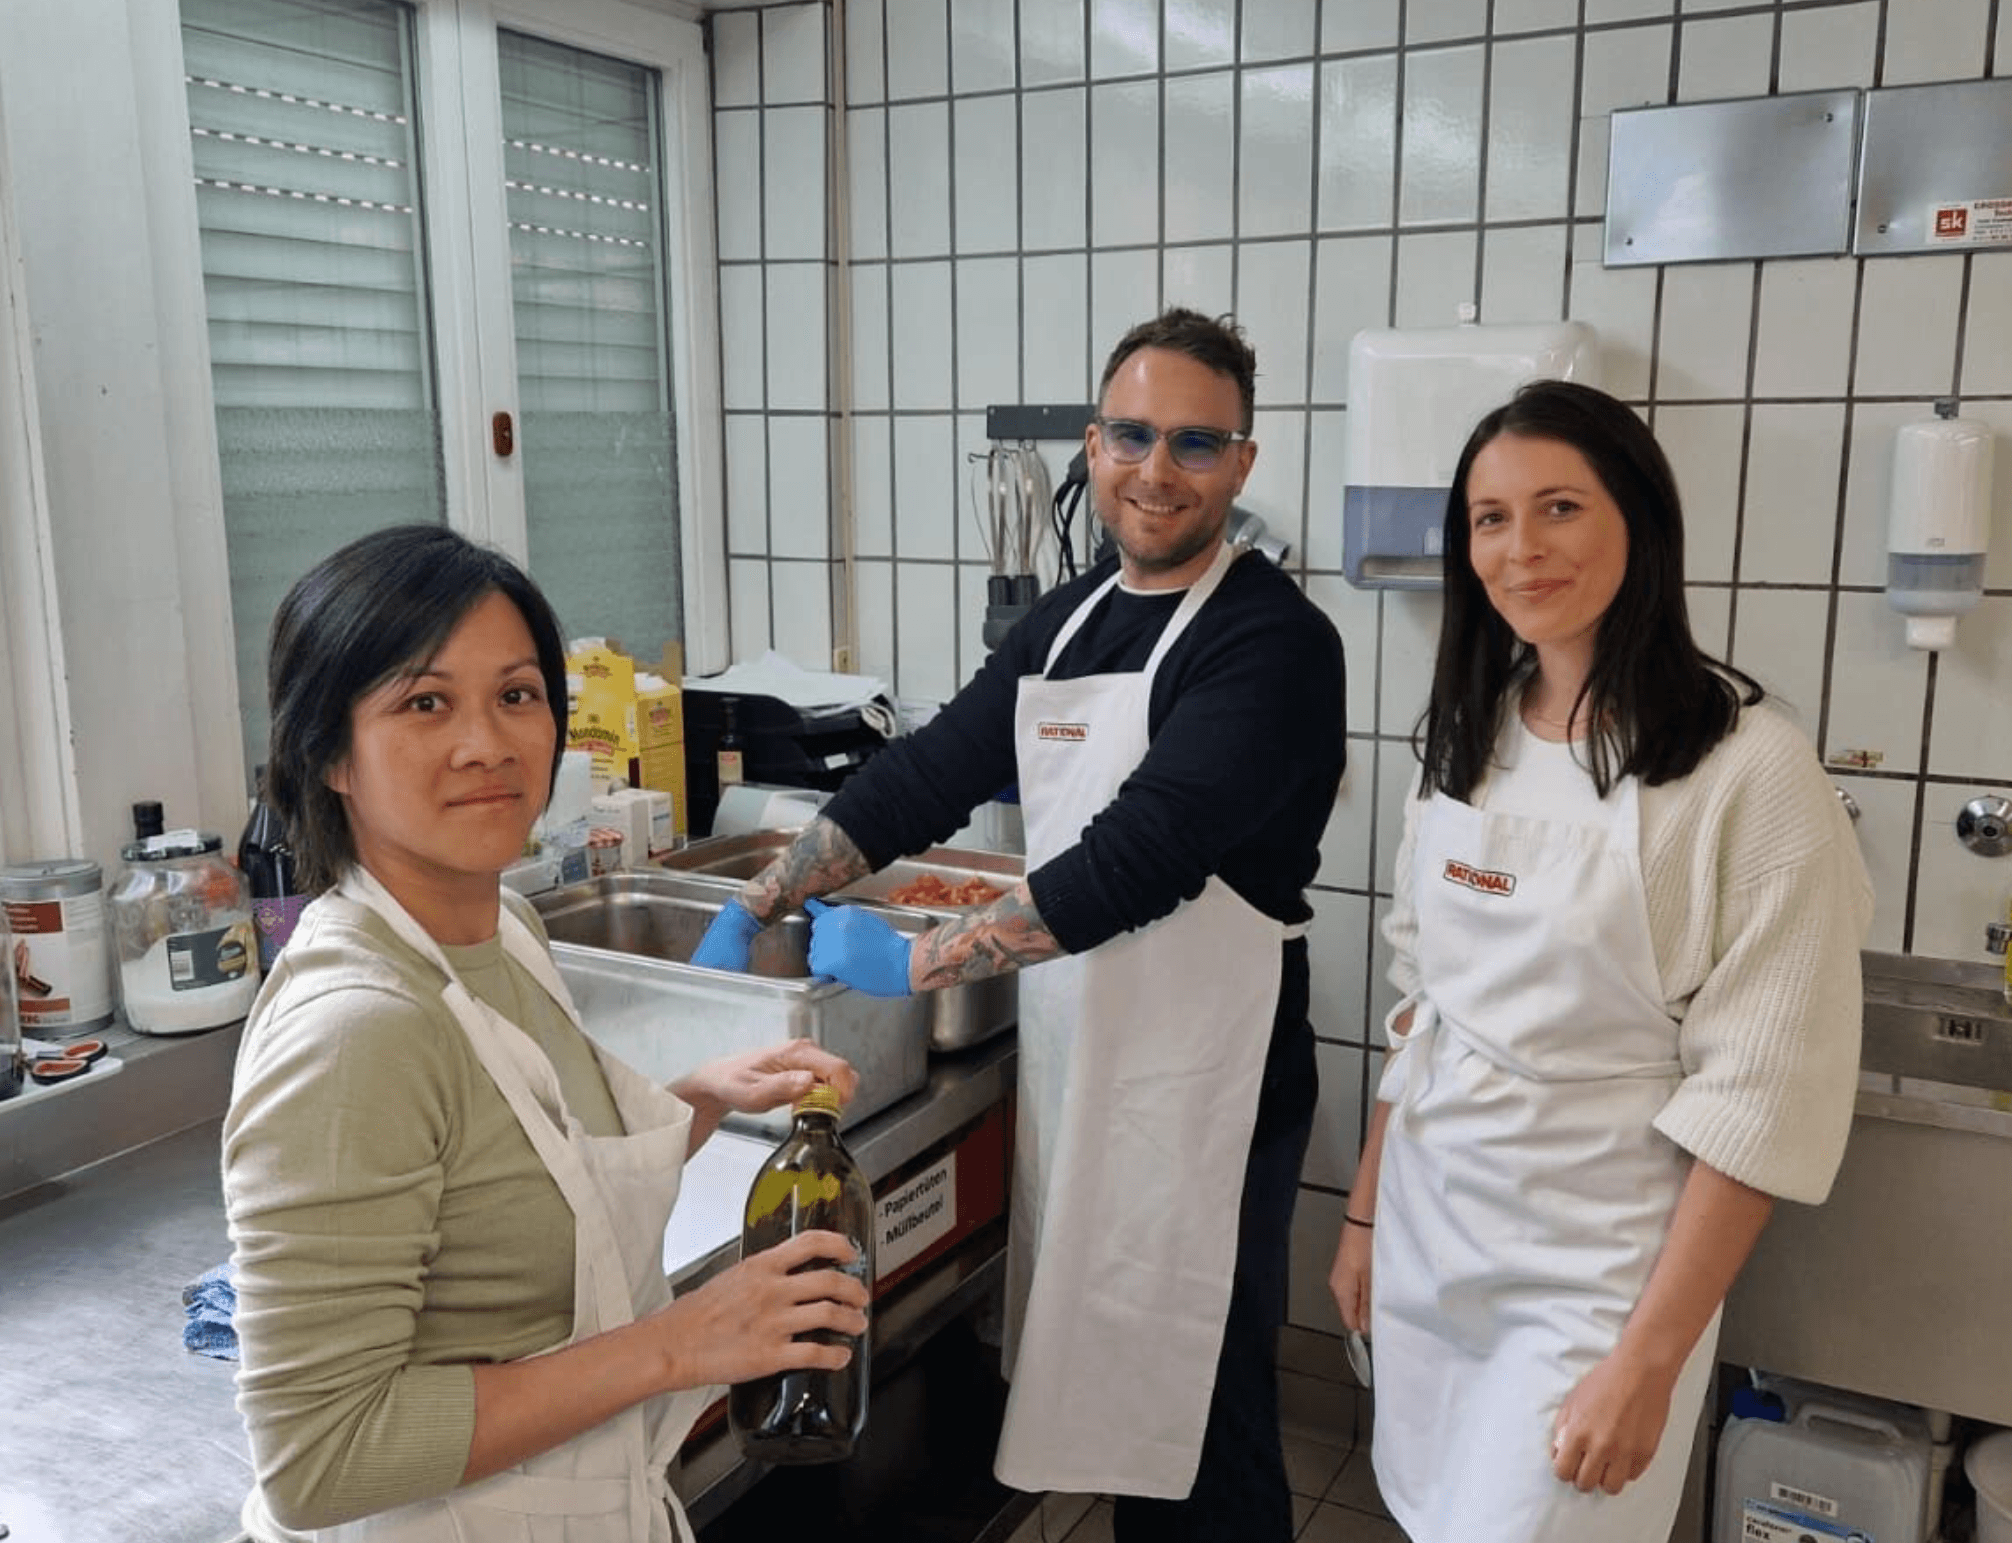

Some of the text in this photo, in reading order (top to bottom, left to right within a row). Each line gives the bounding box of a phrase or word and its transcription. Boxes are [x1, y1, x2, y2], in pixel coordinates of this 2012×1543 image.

[1940, 211, 1964, 230] sk
[1040, 725, 1086, 738] RATIONAL
[1446, 862, 1511, 892] RATIONAL
